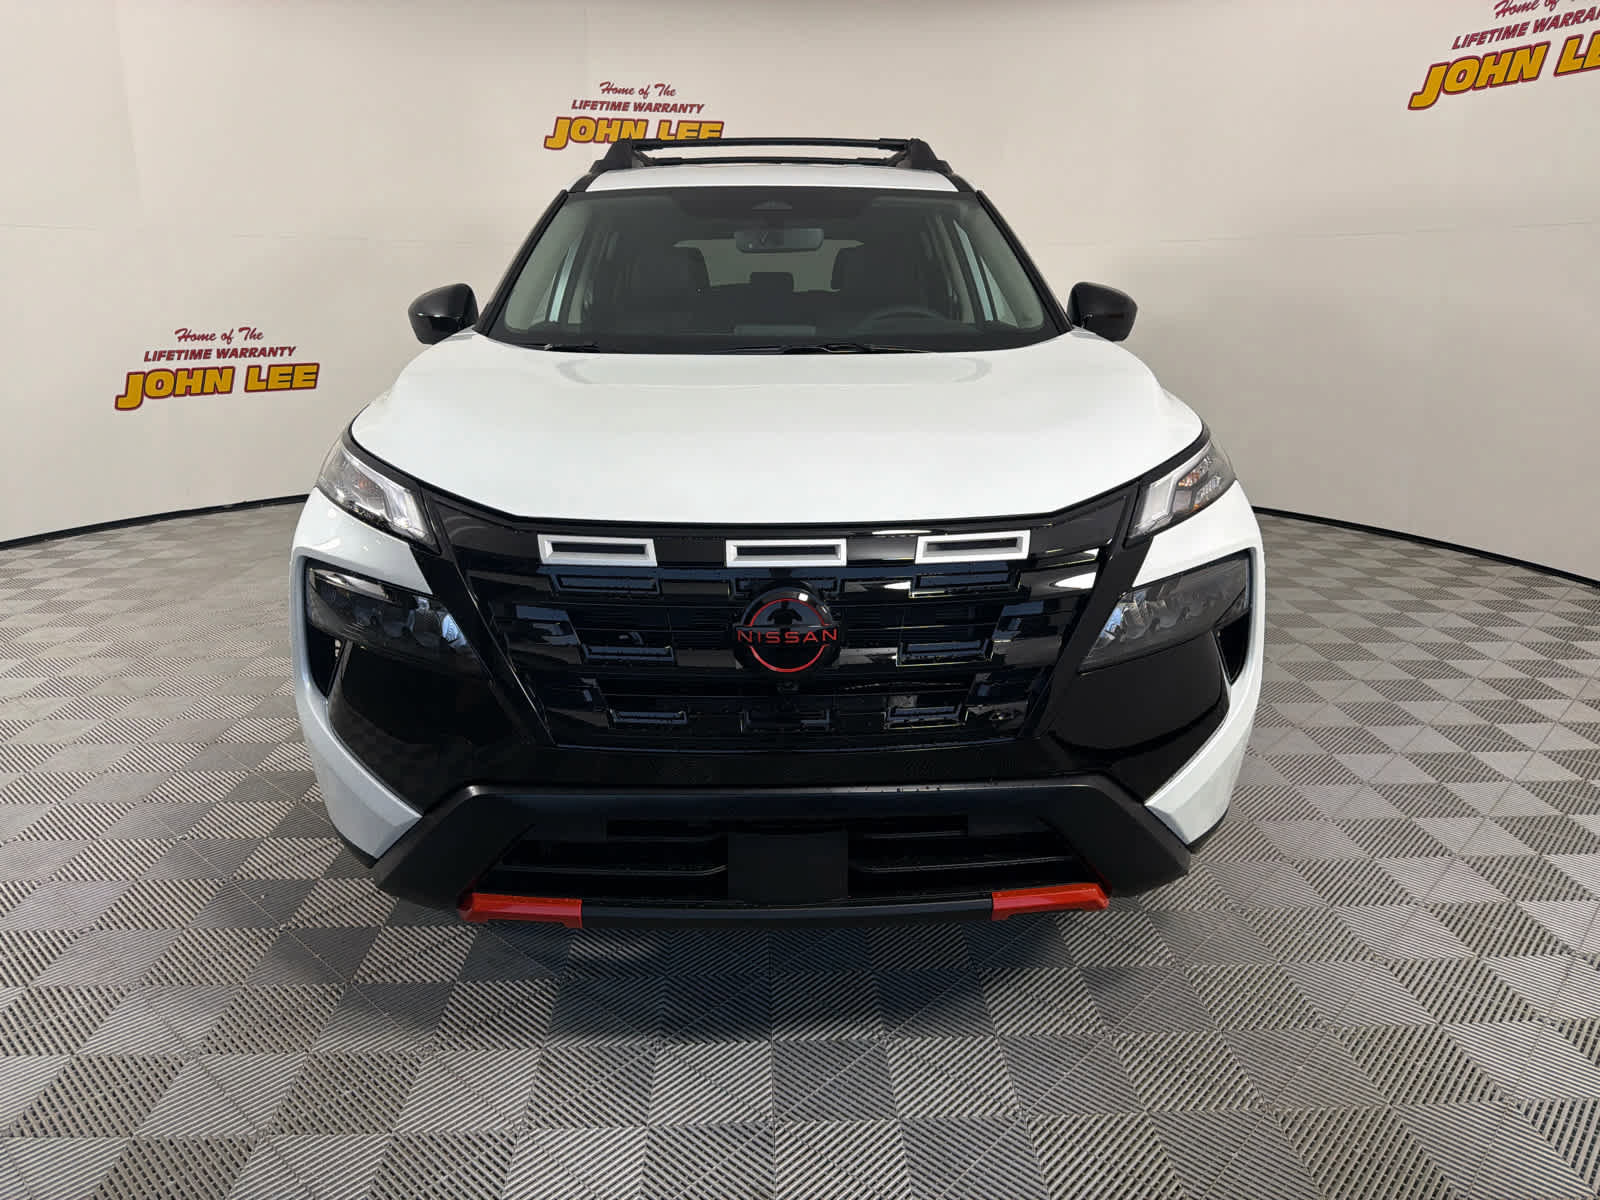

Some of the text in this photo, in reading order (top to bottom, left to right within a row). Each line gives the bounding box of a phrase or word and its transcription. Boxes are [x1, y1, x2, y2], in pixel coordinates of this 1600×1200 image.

[1494, 0, 1540, 19] Home
[1451, 6, 1600, 49] LIFETIME WARRA
[1408, 41, 1551, 110] JOHN
[600, 82, 676, 98] Home of The
[571, 100, 704, 114] LIFETIME WARRANTY
[544, 116, 724, 150] JOHN LEE
[174, 327, 264, 344] Home of The
[144, 346, 296, 362] LIFETIME WARRANTY
[115, 363, 320, 411] JOHN LEE
[737, 629, 837, 644] NISSAN
